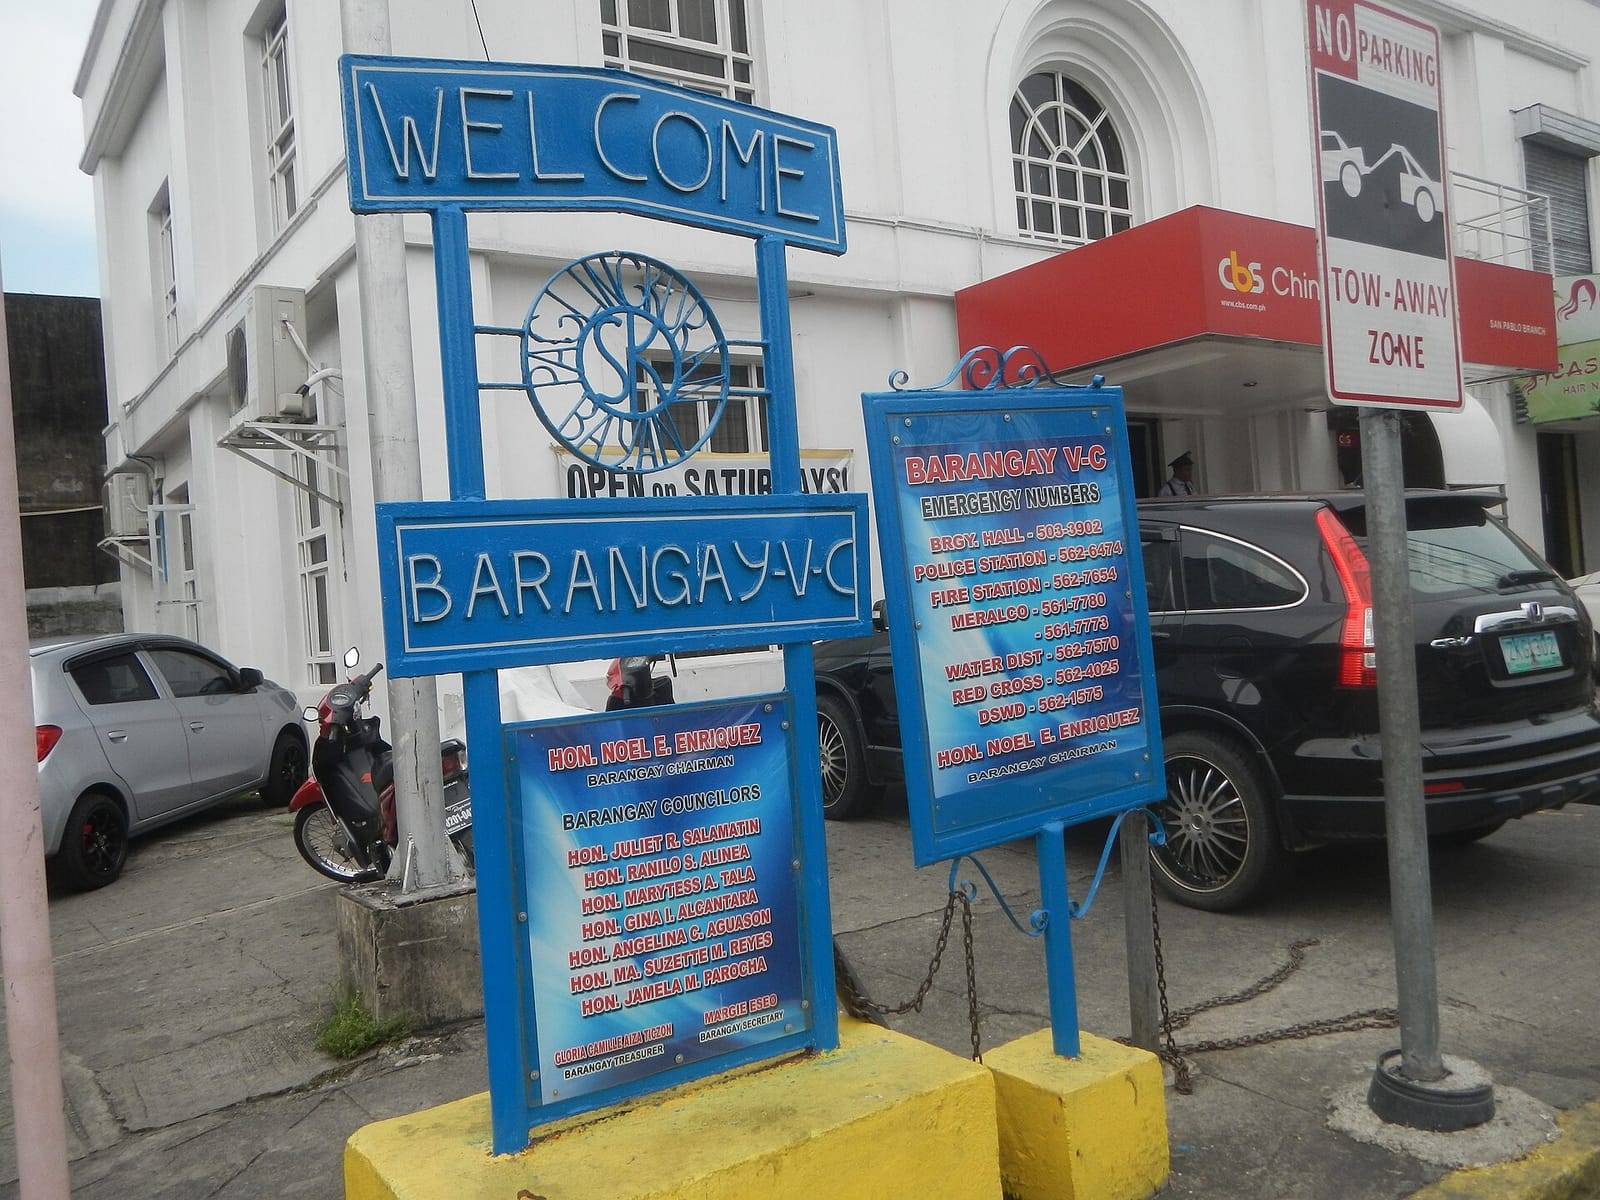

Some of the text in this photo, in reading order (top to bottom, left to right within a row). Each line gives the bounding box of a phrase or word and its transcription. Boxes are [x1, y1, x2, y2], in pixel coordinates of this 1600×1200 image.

[1314, 4, 1436, 87] NO PARKING
[365, 80, 820, 222] WELCOME
[1220, 299, 1267, 313] www.cbs.com.ph
[1330, 265, 1449, 318] TOW-AWAY
[1490, 319, 1546, 336] SAN PABLO BRANCH
[1367, 329, 1425, 369] ZONE
[567, 463, 645, 499] OPEN
[684, 467, 848, 497] SATURAYS!
[905, 444, 1107, 486] BARANGAY V-C
[921, 482, 1100, 520] EMERGENCY NUMBERS
[929, 533, 980, 553] BRGY.
[982, 527, 1024, 549] HALL
[1036, 519, 1102, 541] 503-3902
[914, 558, 975, 582] POLICE
[978, 550, 1046, 574] STATION
[1058, 541, 1123, 563] 562-6474
[930, 586, 969, 607] FIRE
[972, 576, 1040, 601] STATION
[1053, 567, 1117, 589] 562-7654
[951, 604, 1028, 631] MERALCO
[1041, 592, 1106, 615] 561-7780
[1044, 615, 1110, 639] 561-7773
[944, 657, 1003, 681] WATER
[1007, 650, 1043, 671] DIST
[1055, 636, 1119, 660] 562-7570
[952, 685, 987, 705] RED
[990, 675, 1043, 698] CROSS
[1055, 659, 1119, 684] 562-4025
[978, 703, 1026, 725] DSWD
[1039, 686, 1103, 711] 562-1575
[548, 723, 761, 773] HON. NOEL E. ENRIQUEZ
[937, 708, 1140, 768] HON. NOEL E. ENRIQUEZ
[587, 755, 734, 787] BARANGAY CHAIRMAN
[967, 740, 1117, 783] BARANGAY CHAIRMAN
[562, 784, 761, 832] BARANGAY COUNCILORS
[567, 818, 761, 867] HON. JULIET R. SALAMATIN
[583, 844, 750, 890] HON. RANILO S. ALINEA
[581, 866, 755, 915] HON. MARYTESS A. TALA
[581, 918, 622, 941] HON.
[624, 911, 662, 933] GINA
[677, 888, 758, 920] ALCANTARA
[568, 908, 771, 969] HON. ANGELINA C. AGUASON
[569, 931, 773, 994] HON. MA. SUZETTE M. REYES
[581, 956, 767, 1017] HON. JAMELA M. PAROCHA
[699, 1010, 785, 1043] BARANGAY SECRETARY
[704, 1000, 747, 1025] MARGIE
[554, 1044, 586, 1067] GLORIA
[587, 1035, 623, 1057] CAMILLE
[564, 1044, 665, 1080] BARANGAY TREASURER
